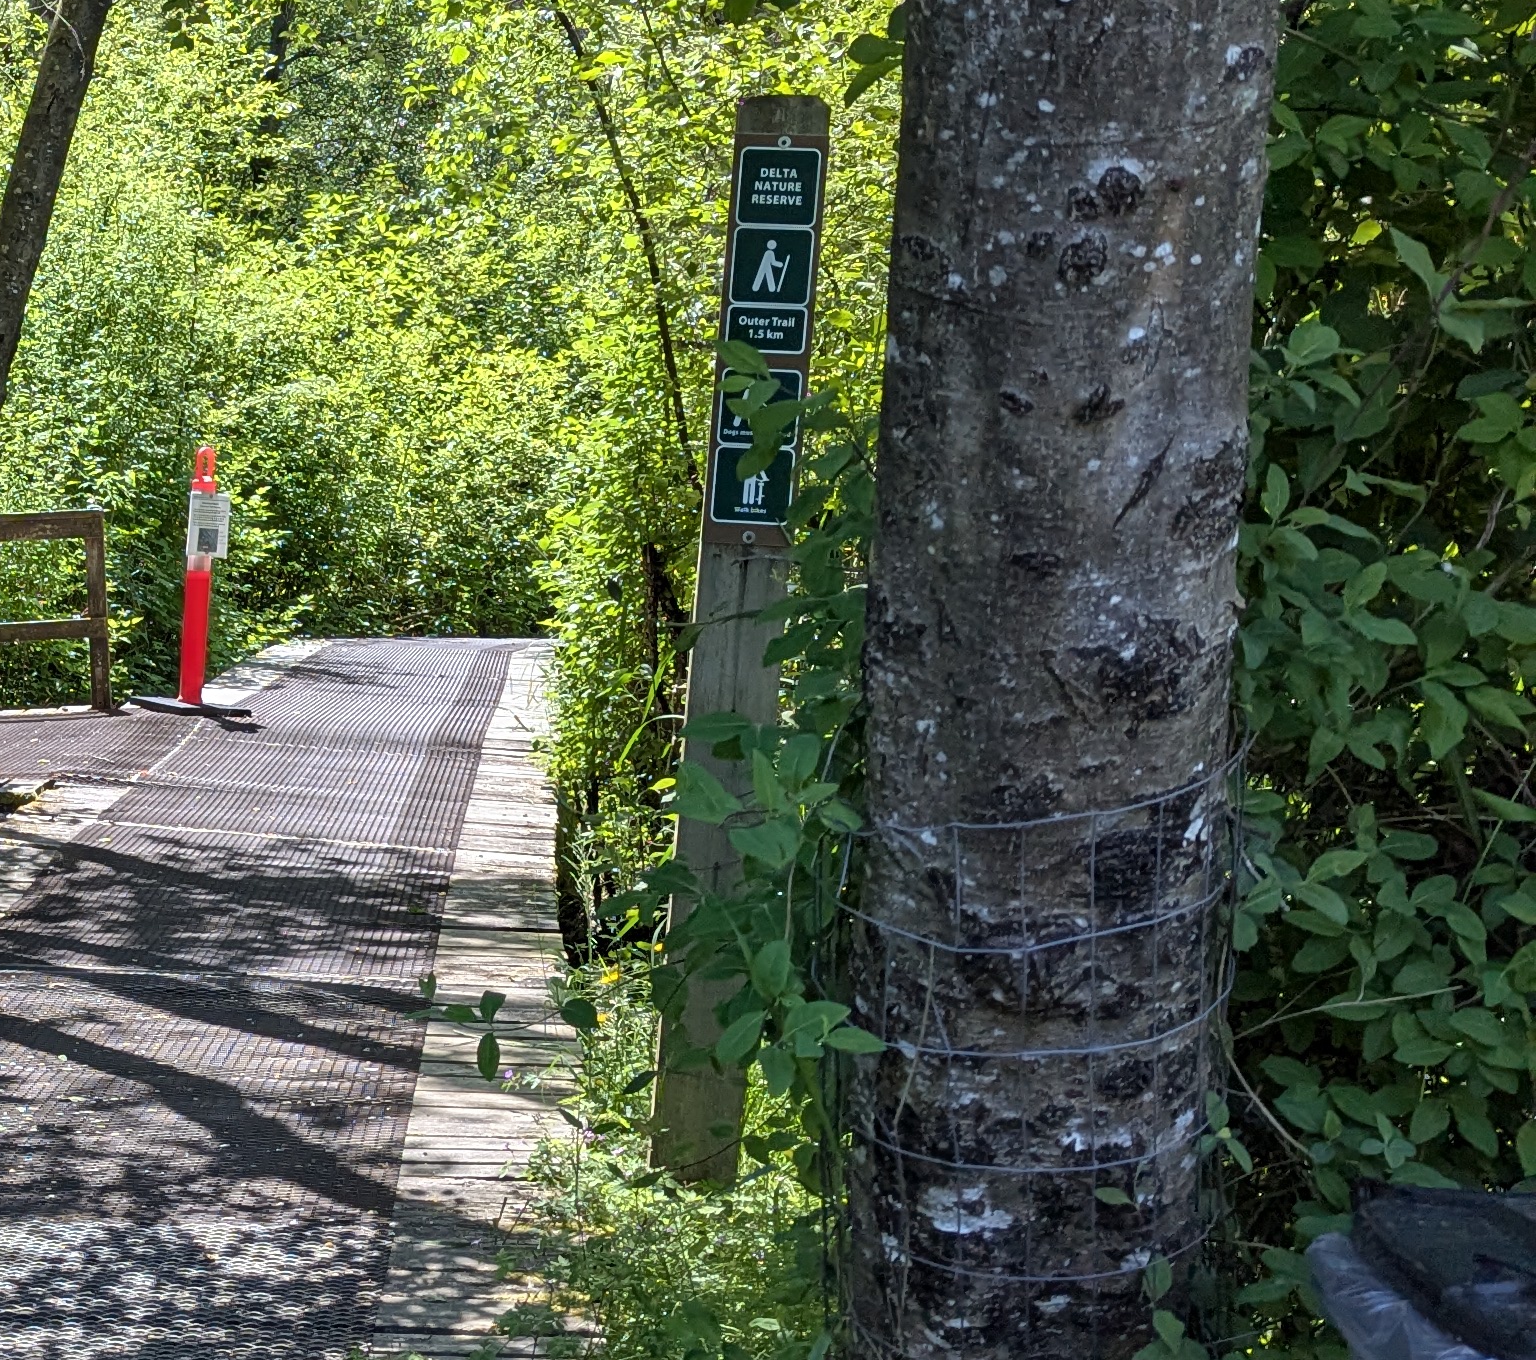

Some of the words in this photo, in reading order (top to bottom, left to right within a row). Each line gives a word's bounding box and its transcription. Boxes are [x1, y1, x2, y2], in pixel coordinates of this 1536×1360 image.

[760, 168, 798, 178] DELTA
[754, 180, 802, 192] NATURE
[751, 194, 803, 206] RESERVE
[738, 316, 770, 326] Outer
[772, 316, 796, 327] Trail
[749, 329, 764, 339] 1.5
[766, 329, 783, 339] km
